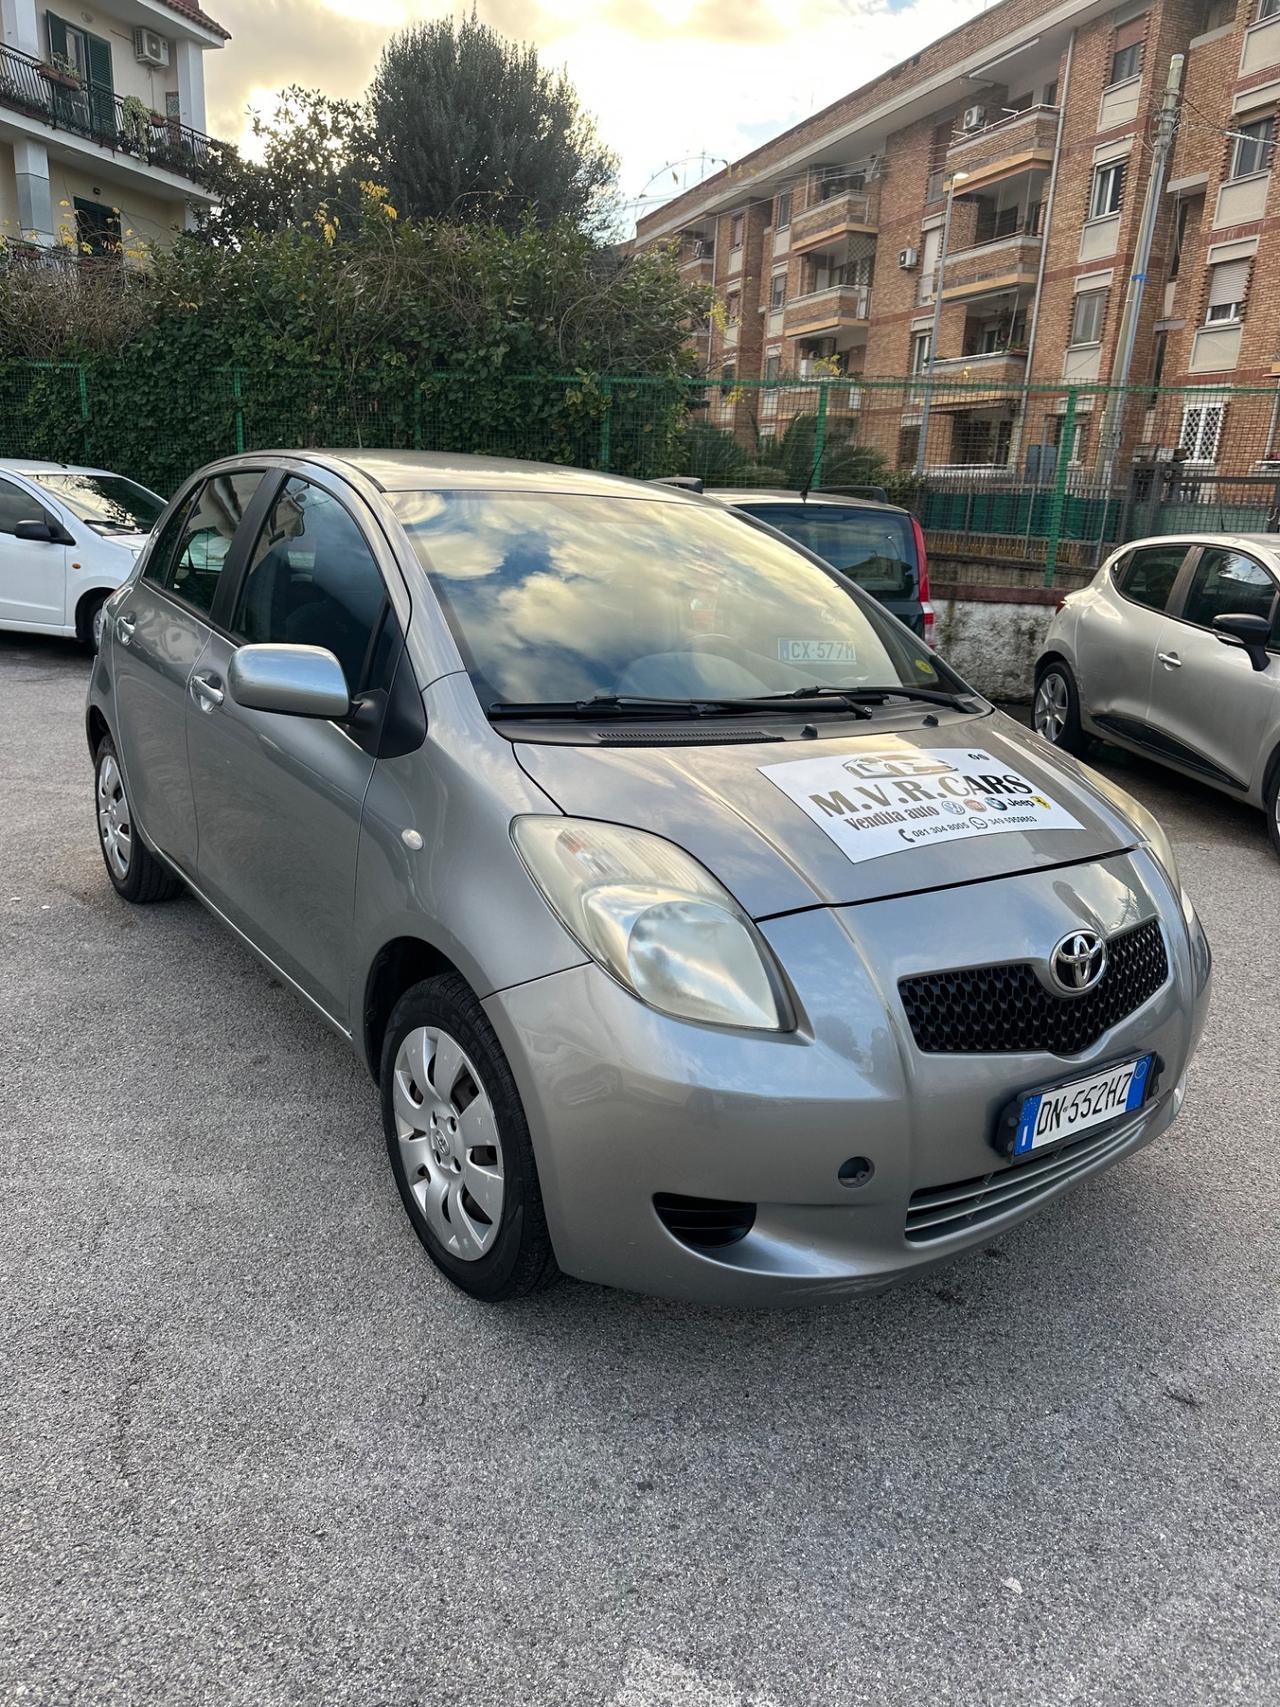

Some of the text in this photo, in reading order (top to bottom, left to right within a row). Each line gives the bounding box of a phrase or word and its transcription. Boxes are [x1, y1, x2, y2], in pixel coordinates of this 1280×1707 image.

[808, 774, 1033, 817] M.V.R.CARS
[1007, 798, 1035, 808] Jeep
[843, 805, 940, 831] Vendita auto
[912, 829, 929, 838] 081
[930, 825, 948, 834] 304
